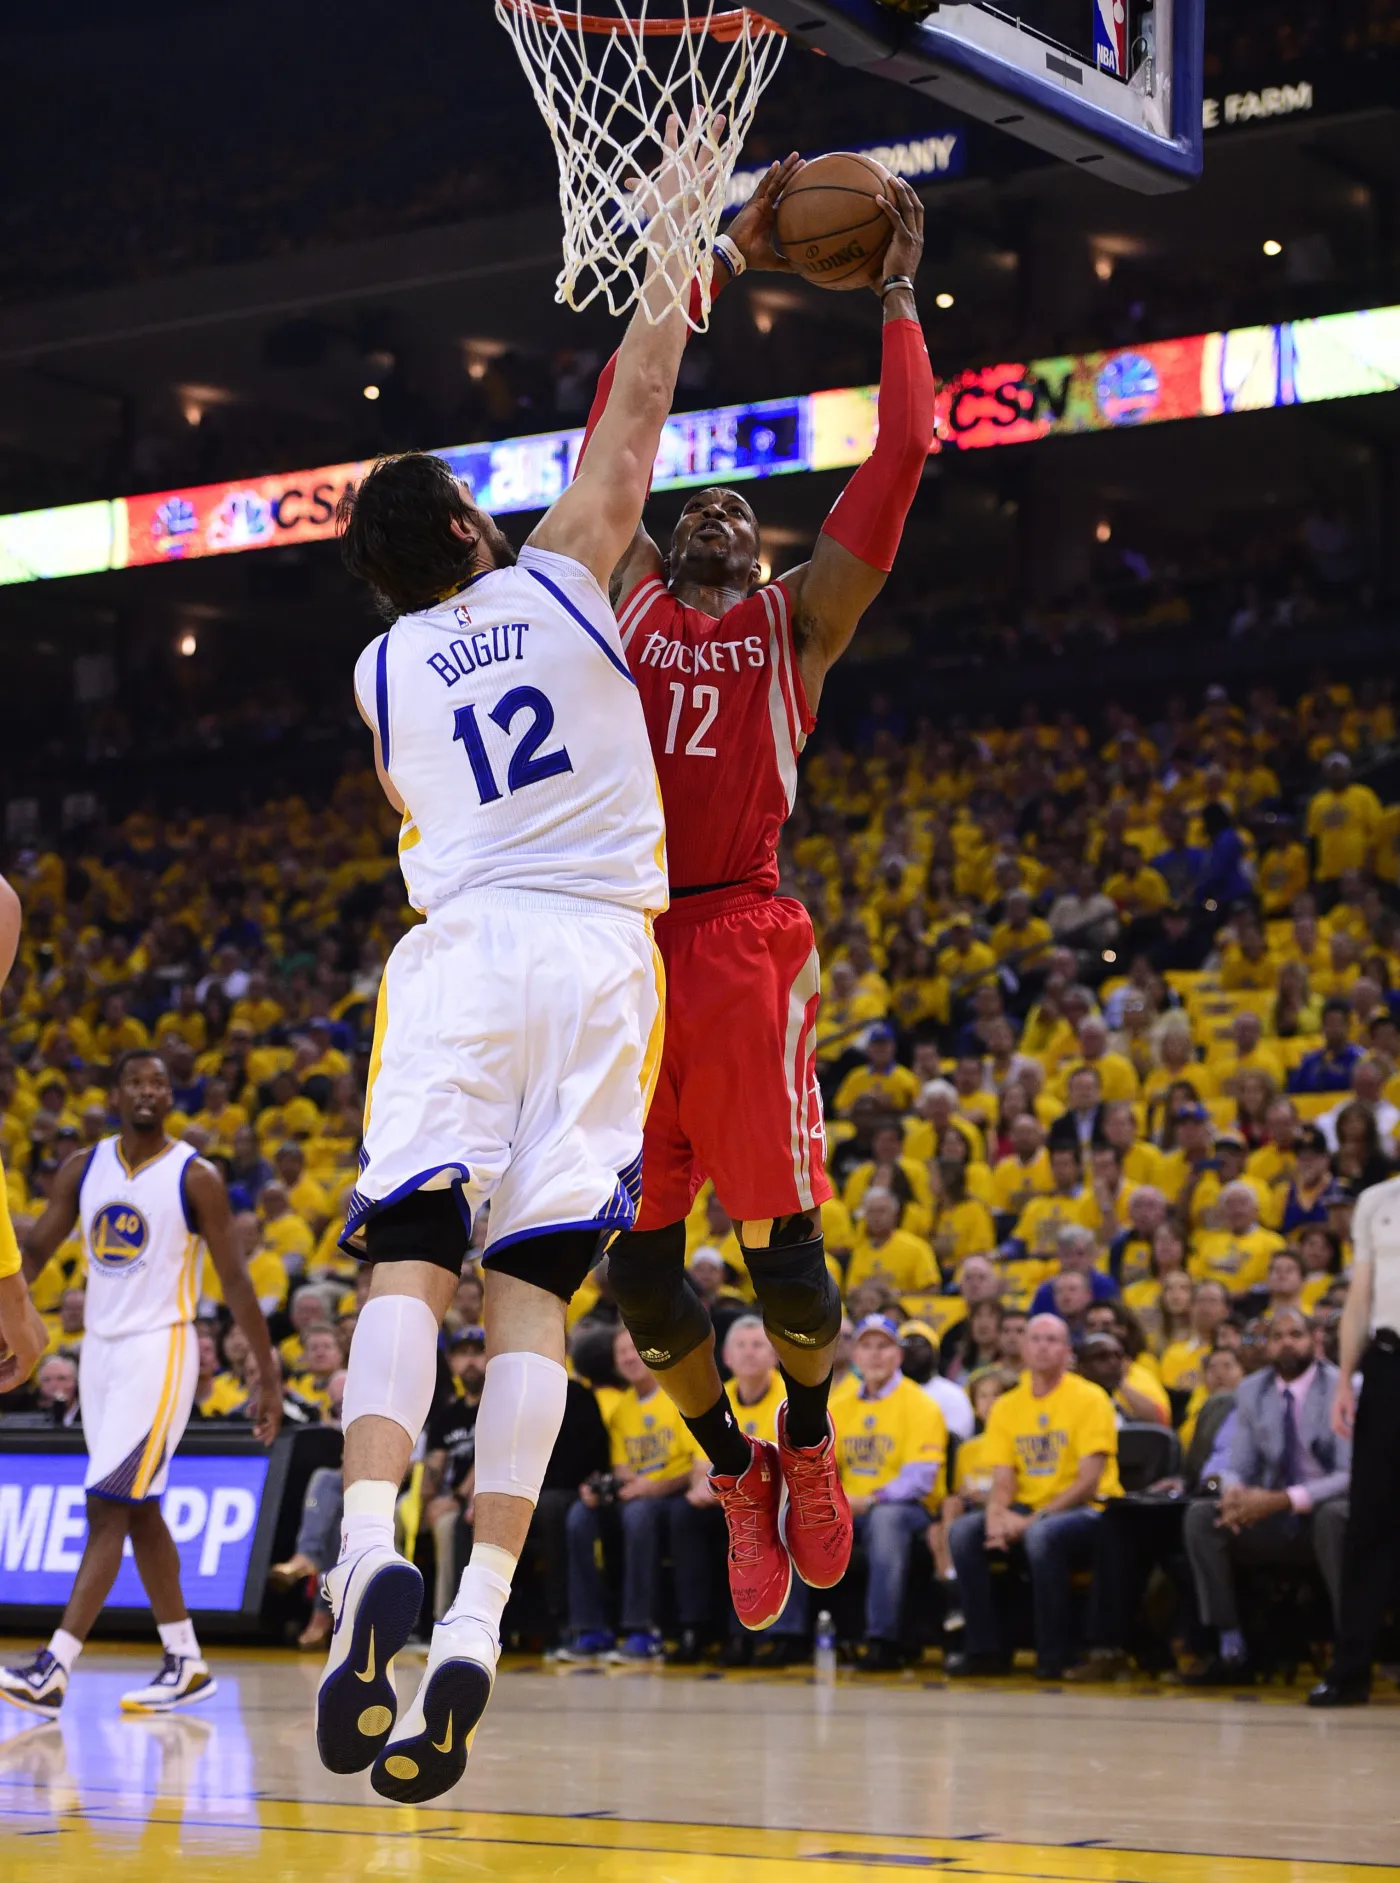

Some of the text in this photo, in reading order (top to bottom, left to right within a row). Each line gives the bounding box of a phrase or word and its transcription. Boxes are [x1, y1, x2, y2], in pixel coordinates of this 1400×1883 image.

[1097, 43, 1115, 70] NBA
[1225, 81, 1312, 124] FARM
[950, 373, 1071, 432] CSN
[277, 481, 354, 529] CS
[426, 624, 529, 687] BOGUT
[639, 630, 765, 677] ROCKETS
[453, 685, 573, 805] 12
[664, 682, 720, 757] 12
[115, 1212, 139, 1234] 40
[163, 1487, 257, 1576] PP
